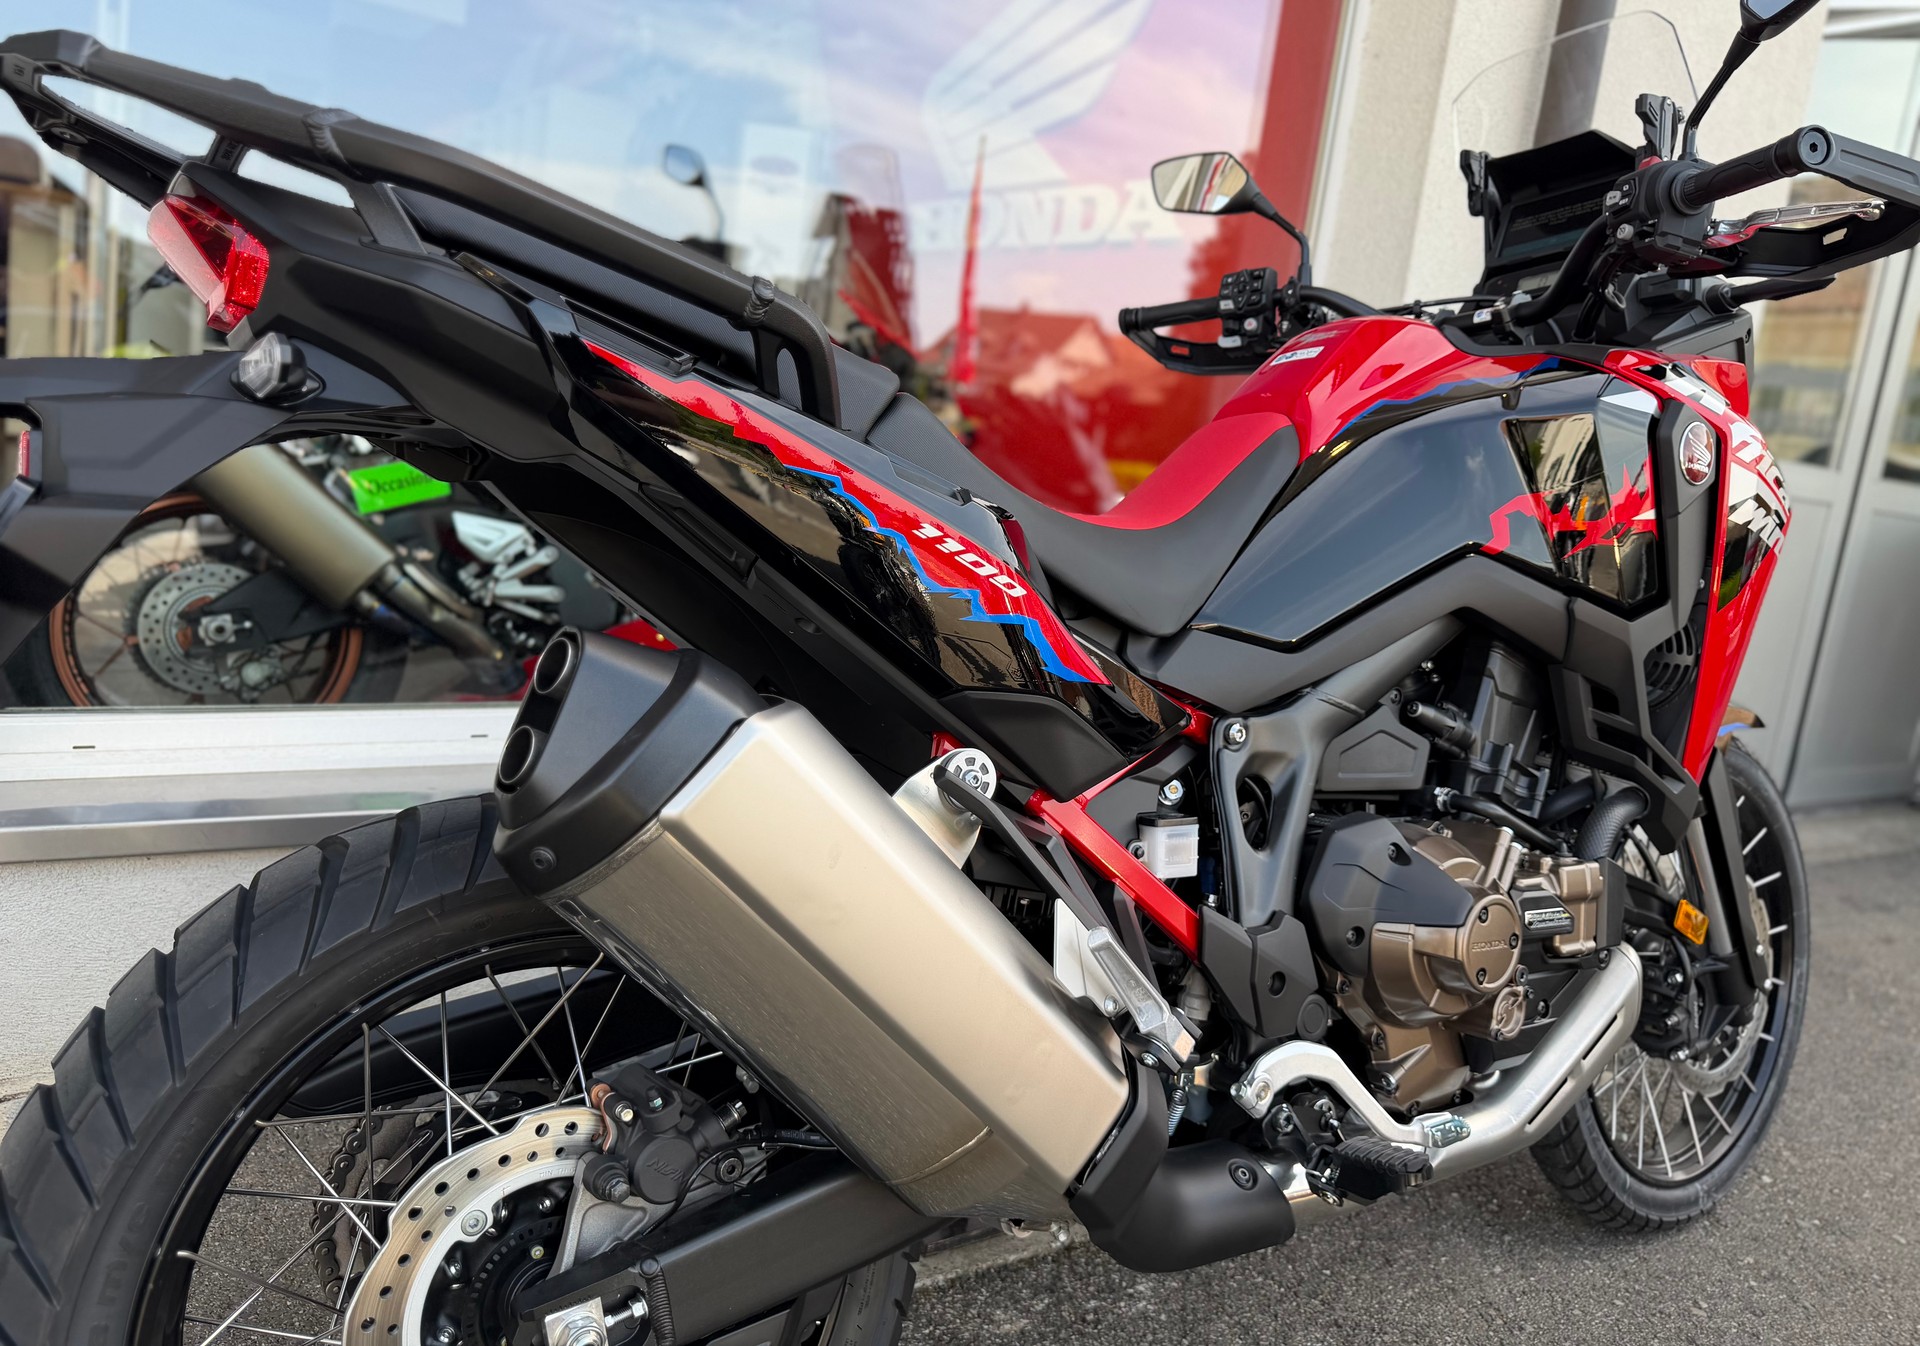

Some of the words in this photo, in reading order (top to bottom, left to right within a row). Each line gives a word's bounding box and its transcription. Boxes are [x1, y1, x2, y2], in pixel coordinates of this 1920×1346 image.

[908, 178, 1184, 253] HONDA
[912, 523, 1027, 597] 1100
[1471, 939, 1508, 952] HONDA
